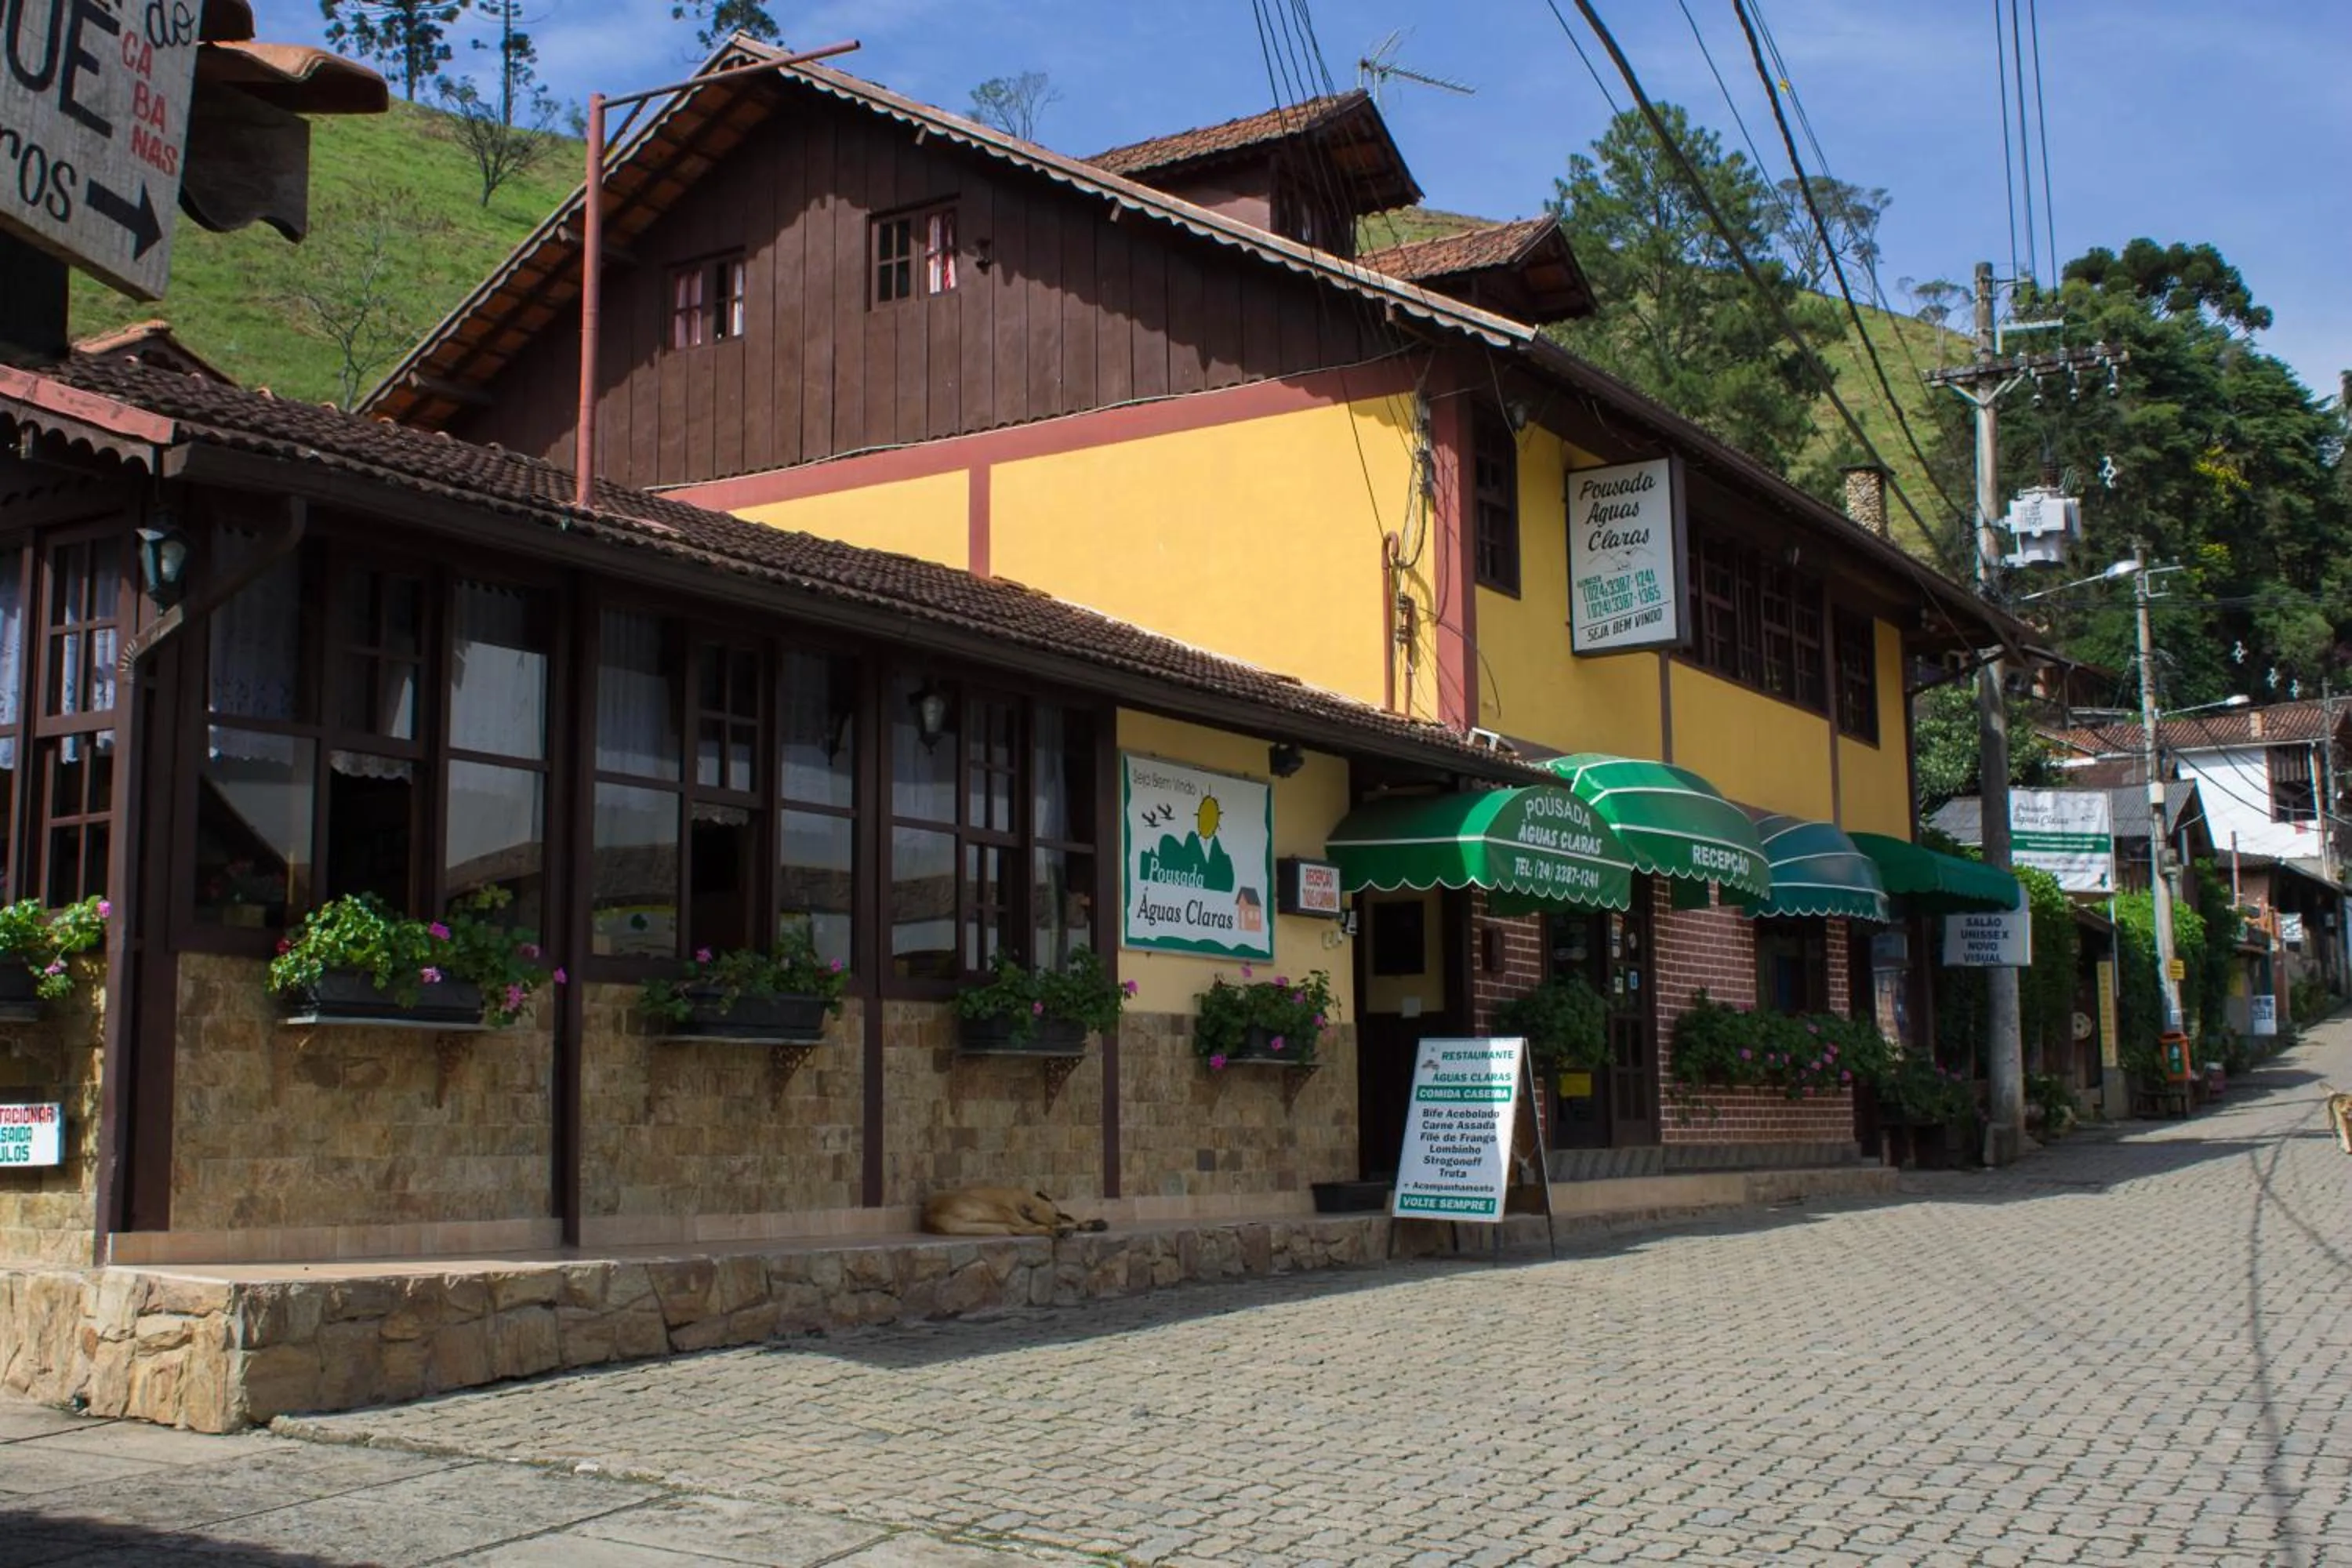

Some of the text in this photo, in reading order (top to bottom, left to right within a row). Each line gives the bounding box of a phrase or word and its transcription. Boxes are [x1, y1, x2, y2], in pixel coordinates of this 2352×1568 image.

[122, 30, 153, 81] CA
[0, 0, 121, 140] UE
[133, 81, 165, 135] BA
[132, 124, 178, 177] NAS
[1579, 472, 1656, 500] Pousada
[1588, 528, 1650, 551] Claras
[1588, 608, 1663, 642] SEJA BEM VINDO
[1525, 795, 1592, 832] POUSADA
[1518, 818, 1602, 855] ÁGUAS CLARAS
[1149, 856, 1205, 888] Pousada
[1693, 844, 1749, 877] RECEPÇÃO
[1137, 886, 1233, 929] Águas Claras
[1968, 942, 1998, 951] NOVO
[1442, 1050, 1515, 1060] RESTAURANTE
[1470, 1072, 1512, 1081] CLARAS
[1419, 1088, 1508, 1098] COMIDA CASEIRA
[1422, 1109, 1500, 1119] Bife Acebolado
[1422, 1120, 1496, 1130] Carne Assada
[1429, 1145, 1481, 1154] Lombinho
[1443, 1132, 1456, 1142] de
[1459, 1133, 1497, 1144] Frango
[1423, 1156, 1482, 1167] Strogonoff
[1439, 1167, 1467, 1178] Truta
[1403, 1196, 1436, 1208] VOLTE
[1439, 1198, 1486, 1210] SEMPRE
